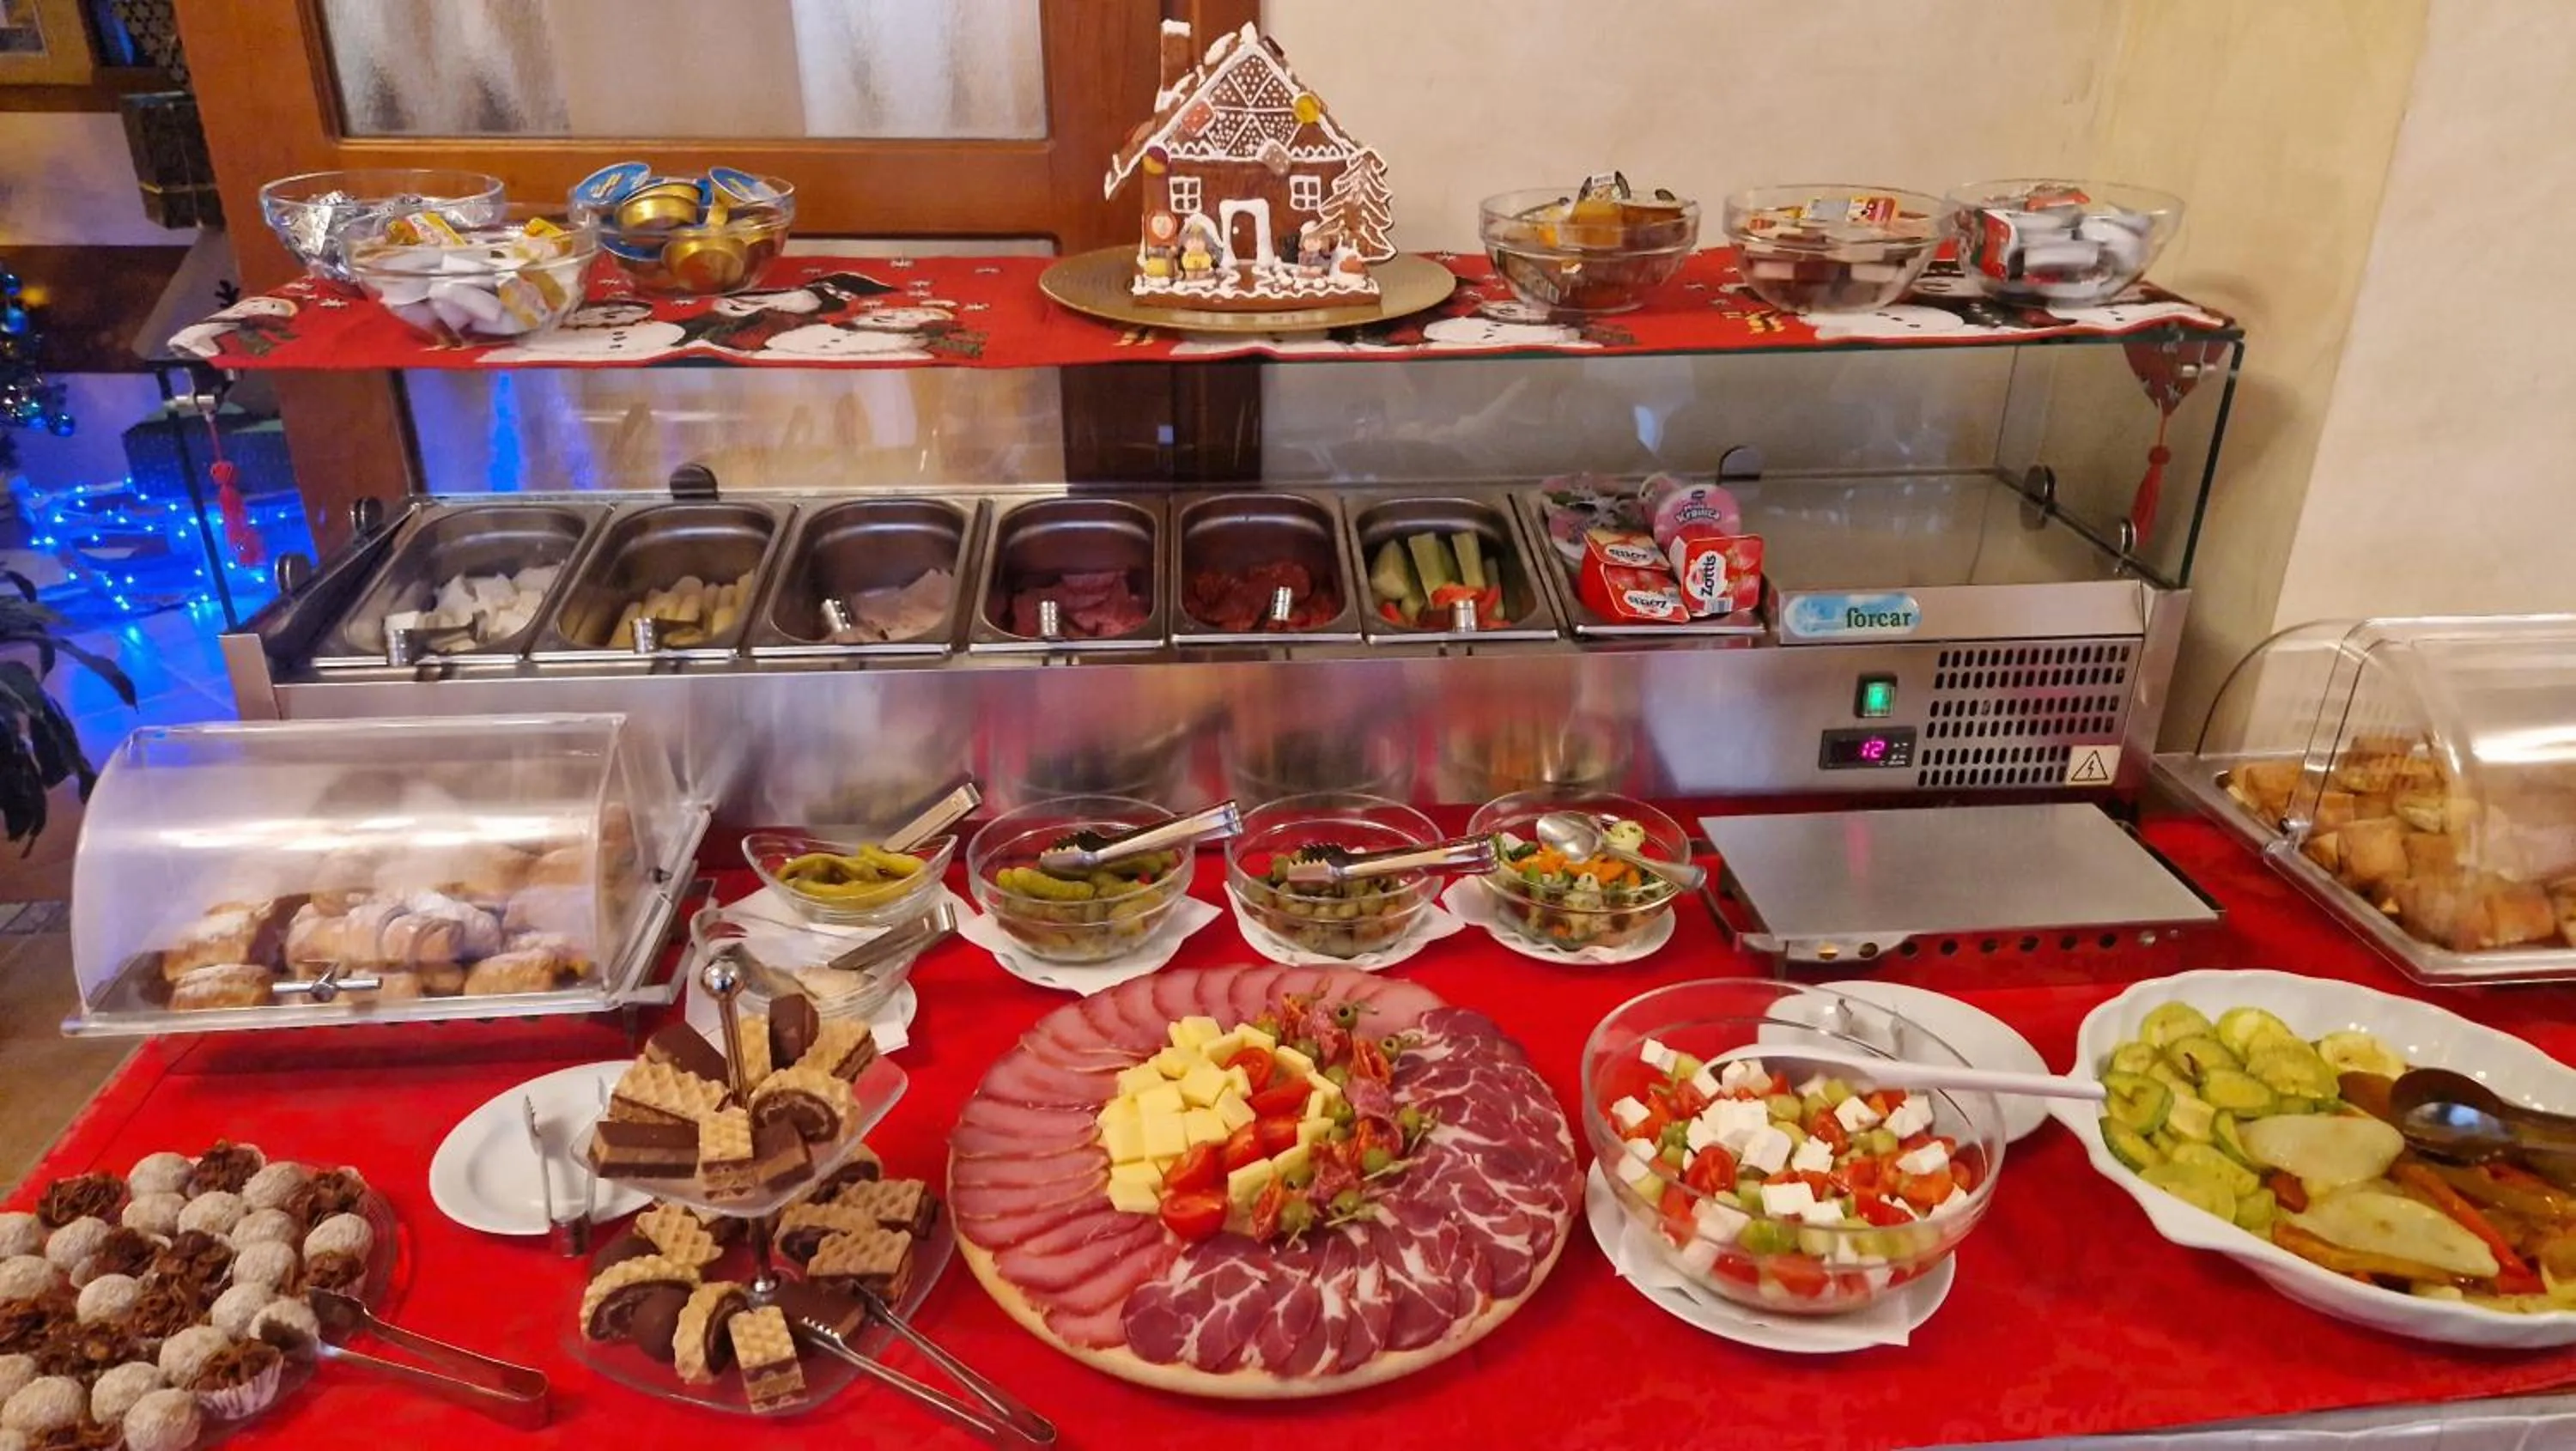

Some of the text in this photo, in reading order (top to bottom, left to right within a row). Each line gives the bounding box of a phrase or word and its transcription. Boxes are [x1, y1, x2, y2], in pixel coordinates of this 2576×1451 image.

[1700, 555, 1717, 598] Zottis
[1845, 607, 1912, 628] forcar
[1862, 741, 1885, 758] 12
